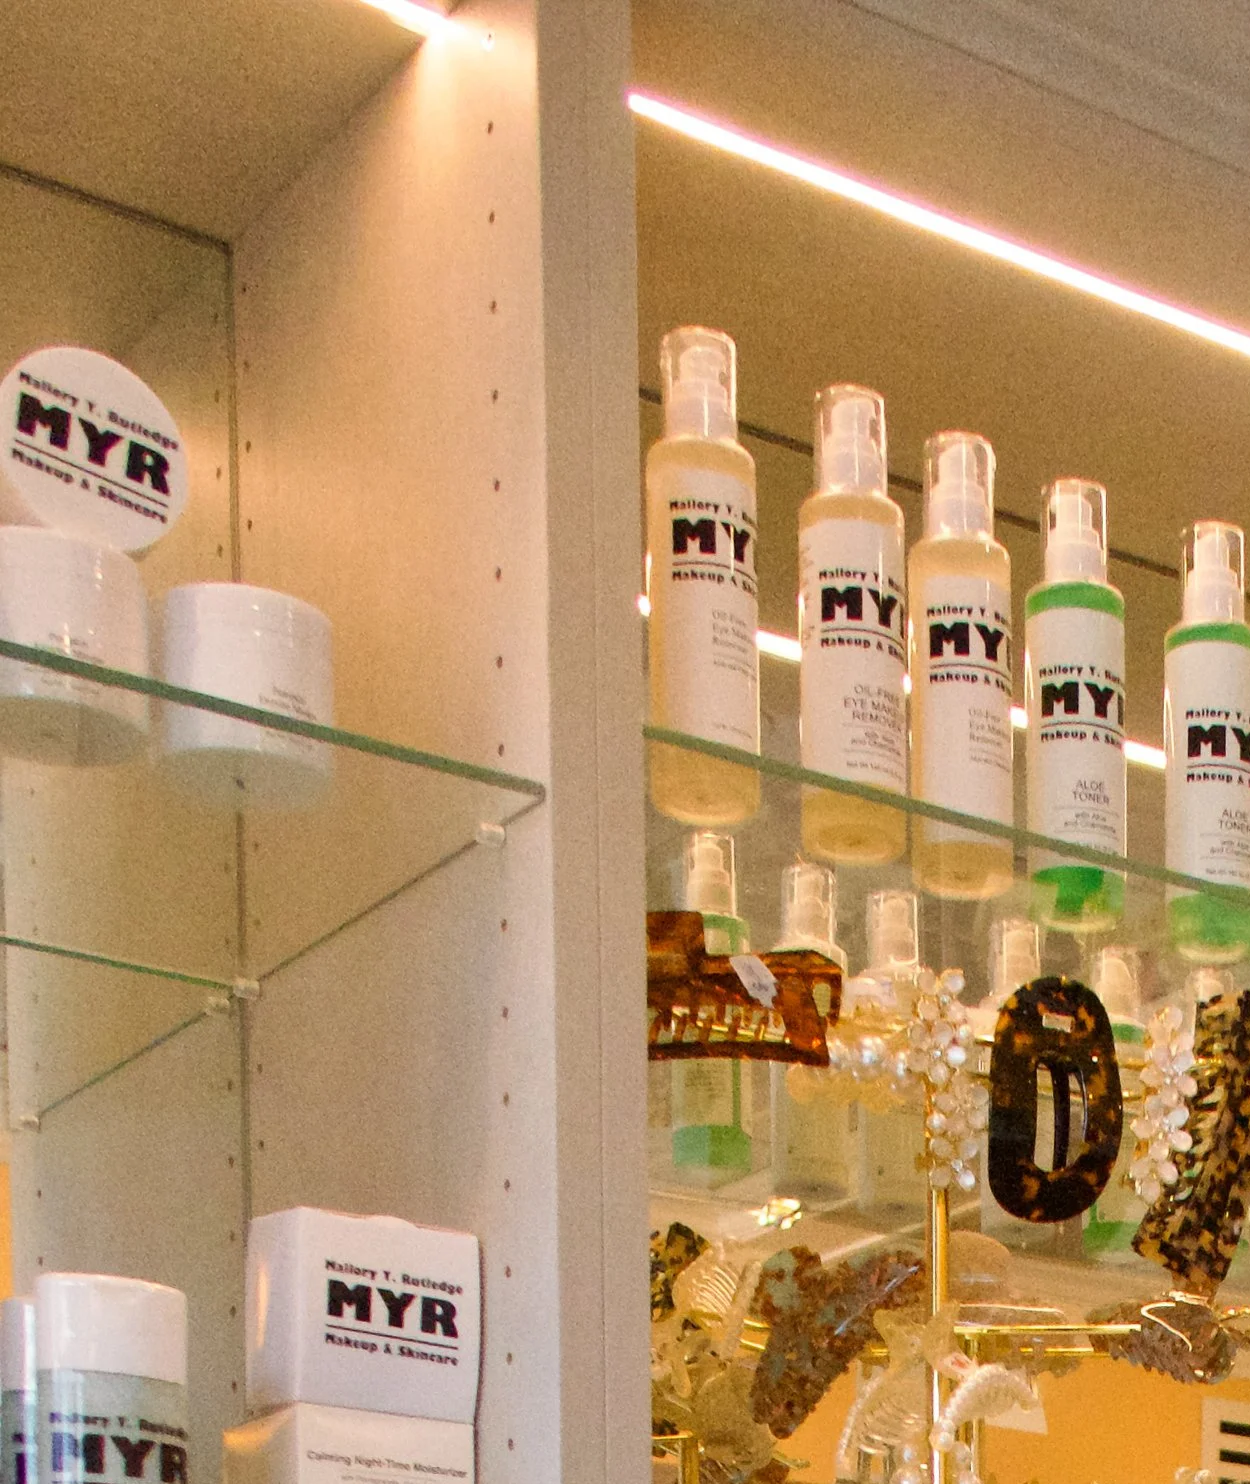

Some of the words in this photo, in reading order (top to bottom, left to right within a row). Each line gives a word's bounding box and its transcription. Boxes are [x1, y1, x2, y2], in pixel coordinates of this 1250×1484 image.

[16, 391, 170, 496] MYR
[12, 449, 74, 483] Makeup
[98, 485, 167, 524] Skincare
[670, 499, 719, 514] Mallory
[672, 570, 724, 584] Makeup
[819, 568, 866, 580] Mallory
[822, 586, 904, 639] MY
[927, 606, 973, 617] Mallory
[821, 637, 870, 648] Makeup
[930, 622, 1011, 672] MY
[929, 671, 978, 684] Makeup
[1039, 664, 1083, 678] Mallory
[1089, 667, 1100, 678] Y.
[1186, 709, 1230, 720] Mallory
[1236, 712, 1246, 723] Y.
[1041, 731, 1086, 743] Makeup
[1092, 731, 1099, 740] &
[1076, 779, 1105, 792] ALOE
[1186, 772, 1233, 783] Makeup
[1237, 773, 1245, 785] &
[1072, 791, 1110, 806] TONER
[1221, 808, 1249, 822] ALOE
[326, 1259, 377, 1280] Mallory
[402, 1274, 463, 1295] Rutledge
[327, 1279, 458, 1339] MYR
[325, 1333, 378, 1354] Makeup
[383, 1344, 391, 1355] &
[398, 1345, 458, 1366] Skincare
[307, 1450, 351, 1465] Calming
[354, 1456, 410, 1471] Night-Time
[413, 1463, 468, 1478] Moisturizer
